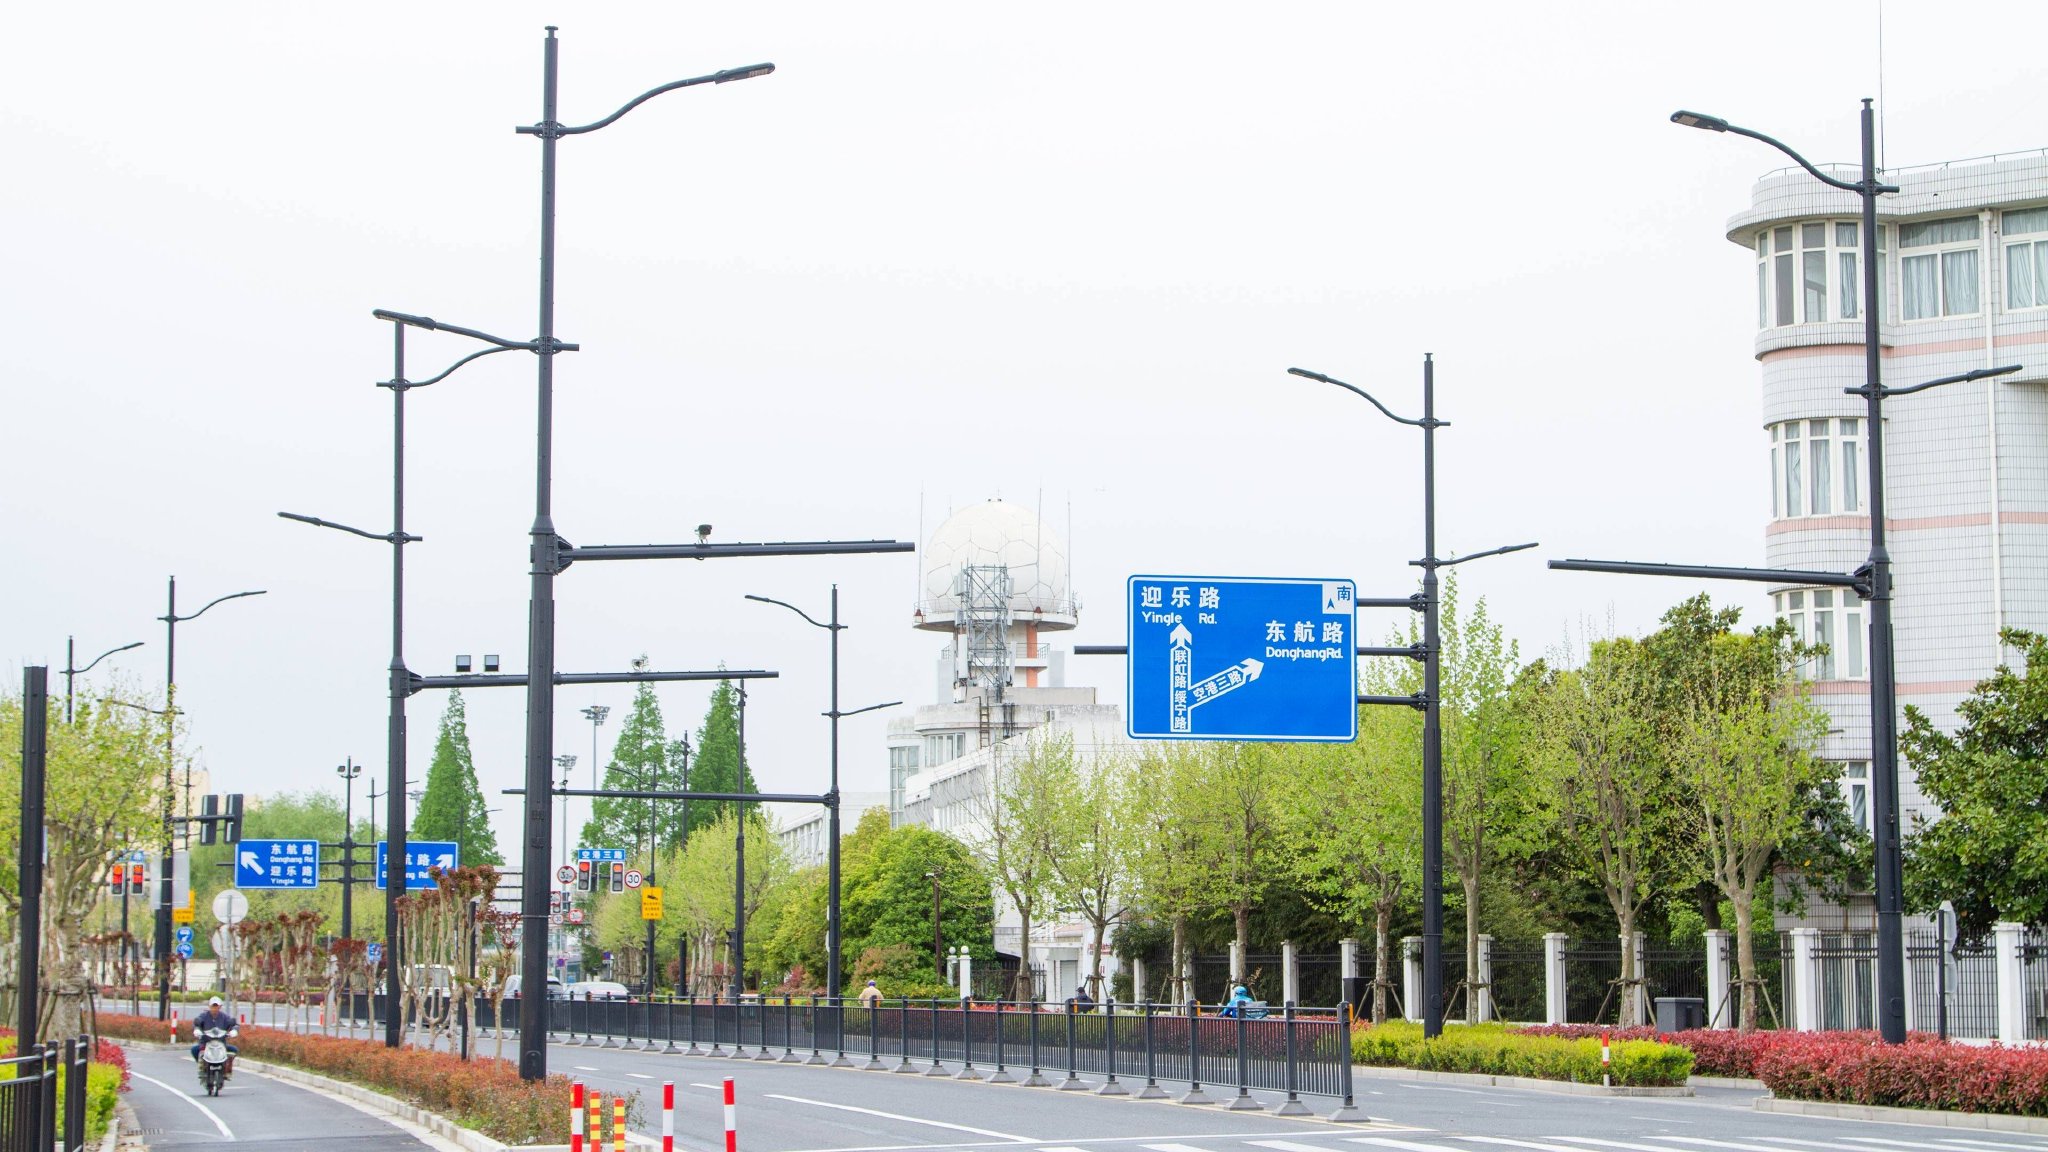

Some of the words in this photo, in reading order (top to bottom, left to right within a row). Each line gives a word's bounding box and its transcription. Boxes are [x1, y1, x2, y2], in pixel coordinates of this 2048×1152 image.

[1141, 586, 1220, 608] 迎乐路
[1337, 586, 1351, 601] 南
[1142, 611, 1182, 626] Yingle
[1199, 613, 1217, 624] Rd.
[1266, 620, 1344, 643] 东航路
[1192, 670, 1241, 702] 空港三路
[271, 844, 313, 855] 东航路
[270, 866, 313, 876] 迎乐路
[627, 874, 640, 884] 30
